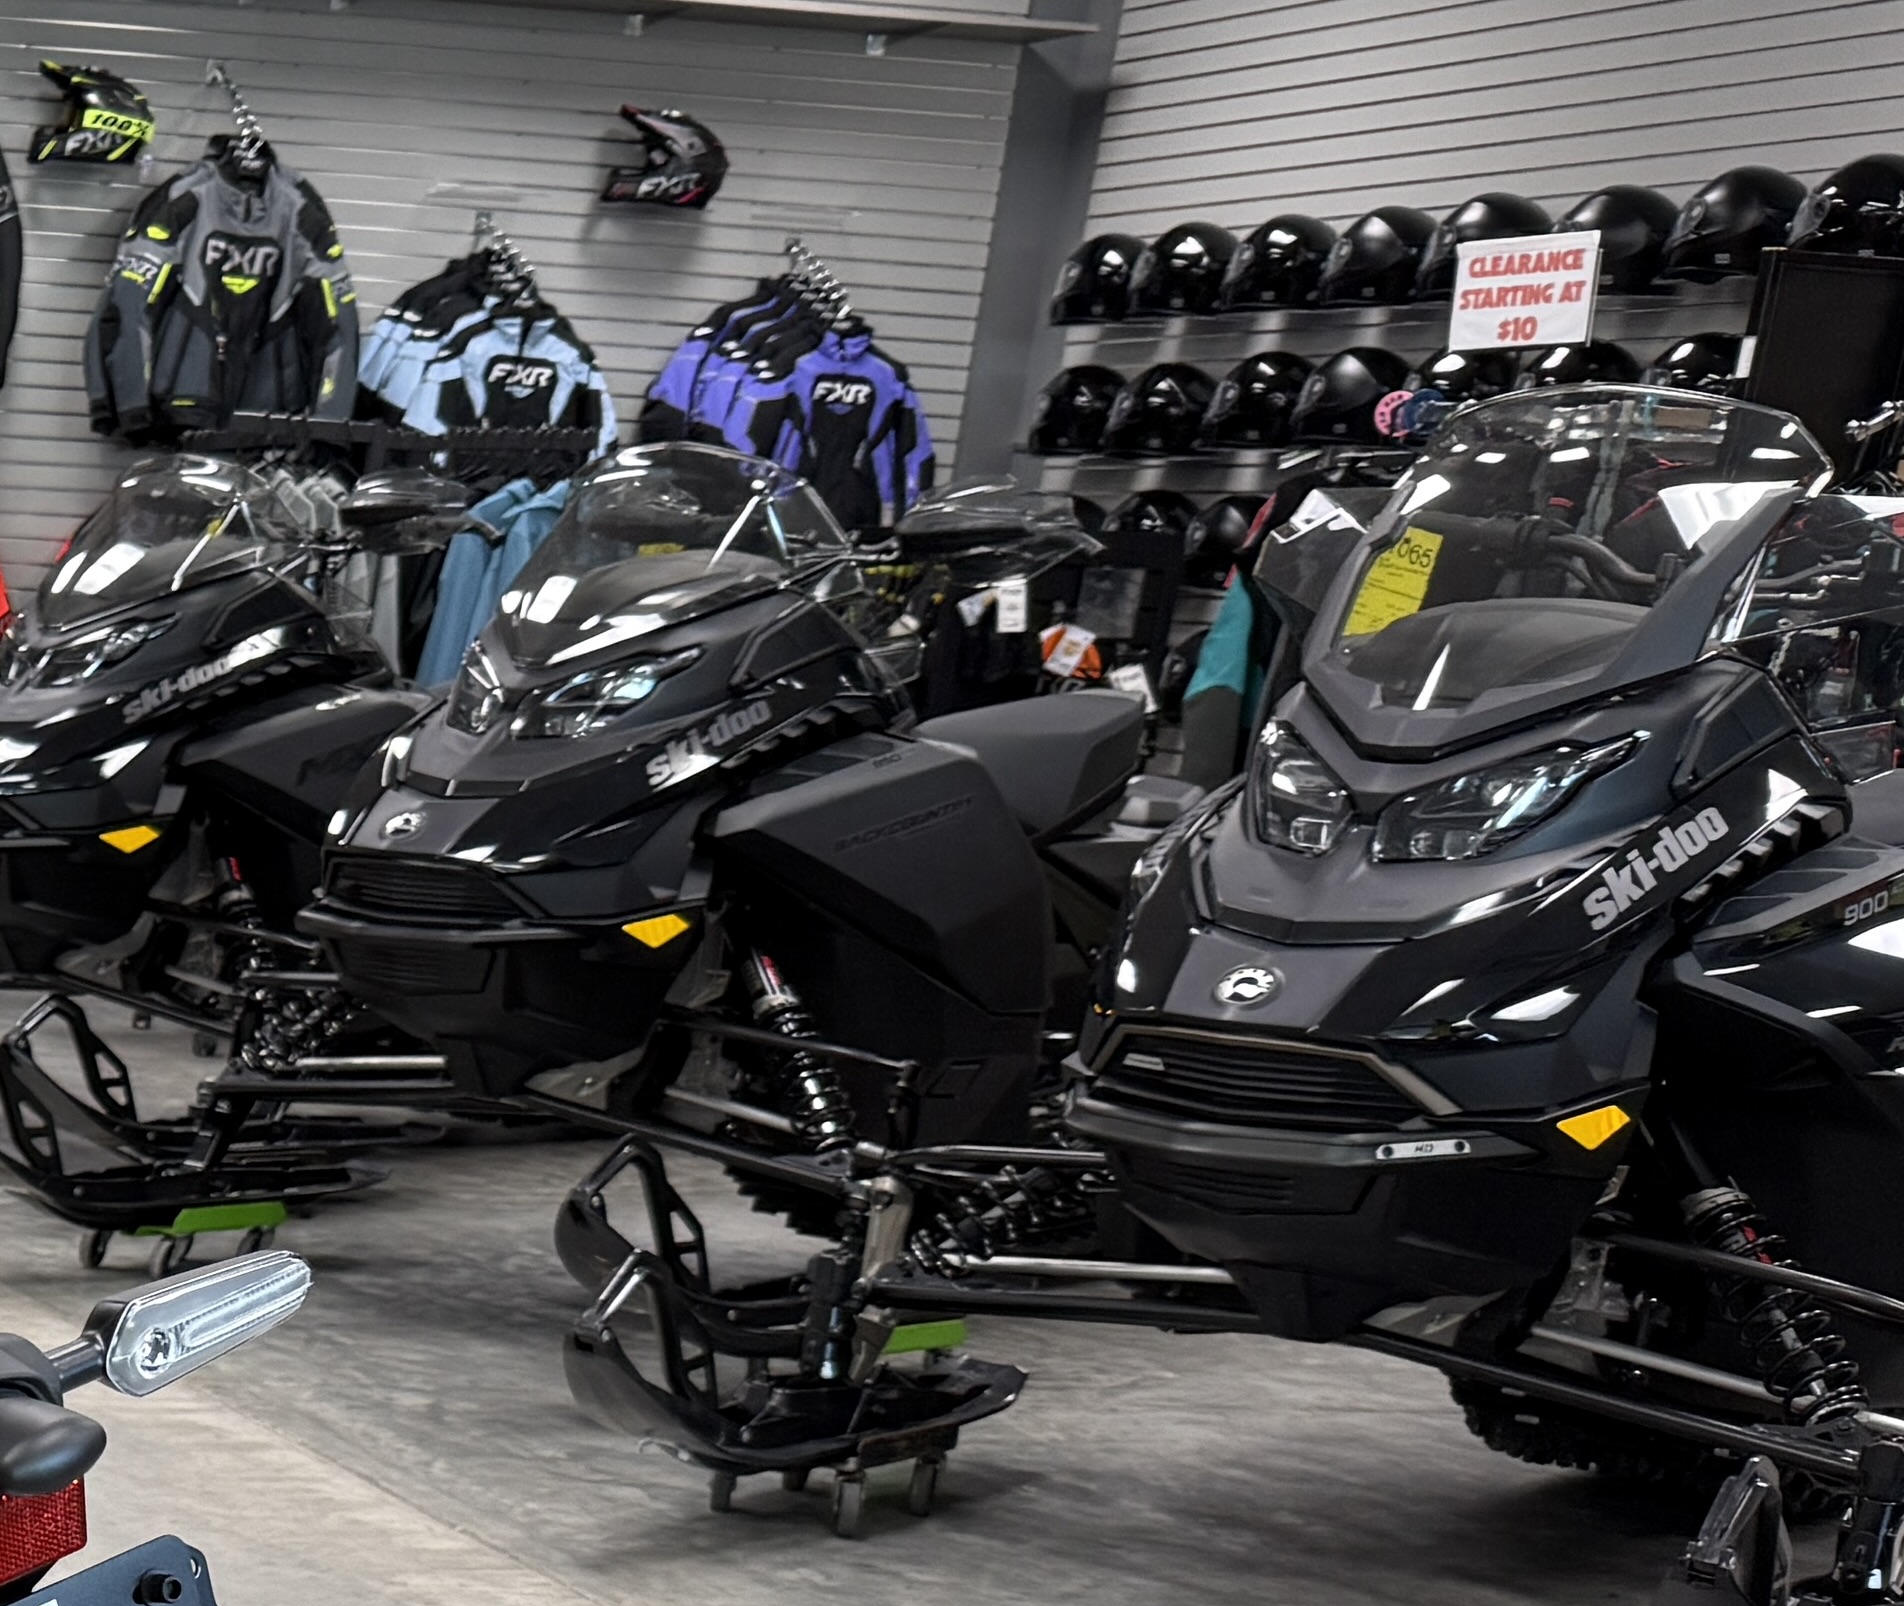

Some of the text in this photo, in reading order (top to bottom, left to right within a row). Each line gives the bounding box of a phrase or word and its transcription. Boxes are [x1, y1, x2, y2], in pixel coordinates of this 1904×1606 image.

[205, 238, 281, 276] FXR
[1469, 248, 1586, 278] CLEARANCE
[1459, 280, 1587, 310] STARTING AT
[1497, 316, 1538, 341] $10
[488, 362, 555, 389] FXR
[813, 380, 875, 406] FXR
[1392, 537, 1434, 568] 065
[122, 654, 234, 724] ski-doo
[645, 700, 773, 787] ski-doo
[1582, 806, 1729, 931] ski-doo
[1843, 890, 1890, 927] 900
